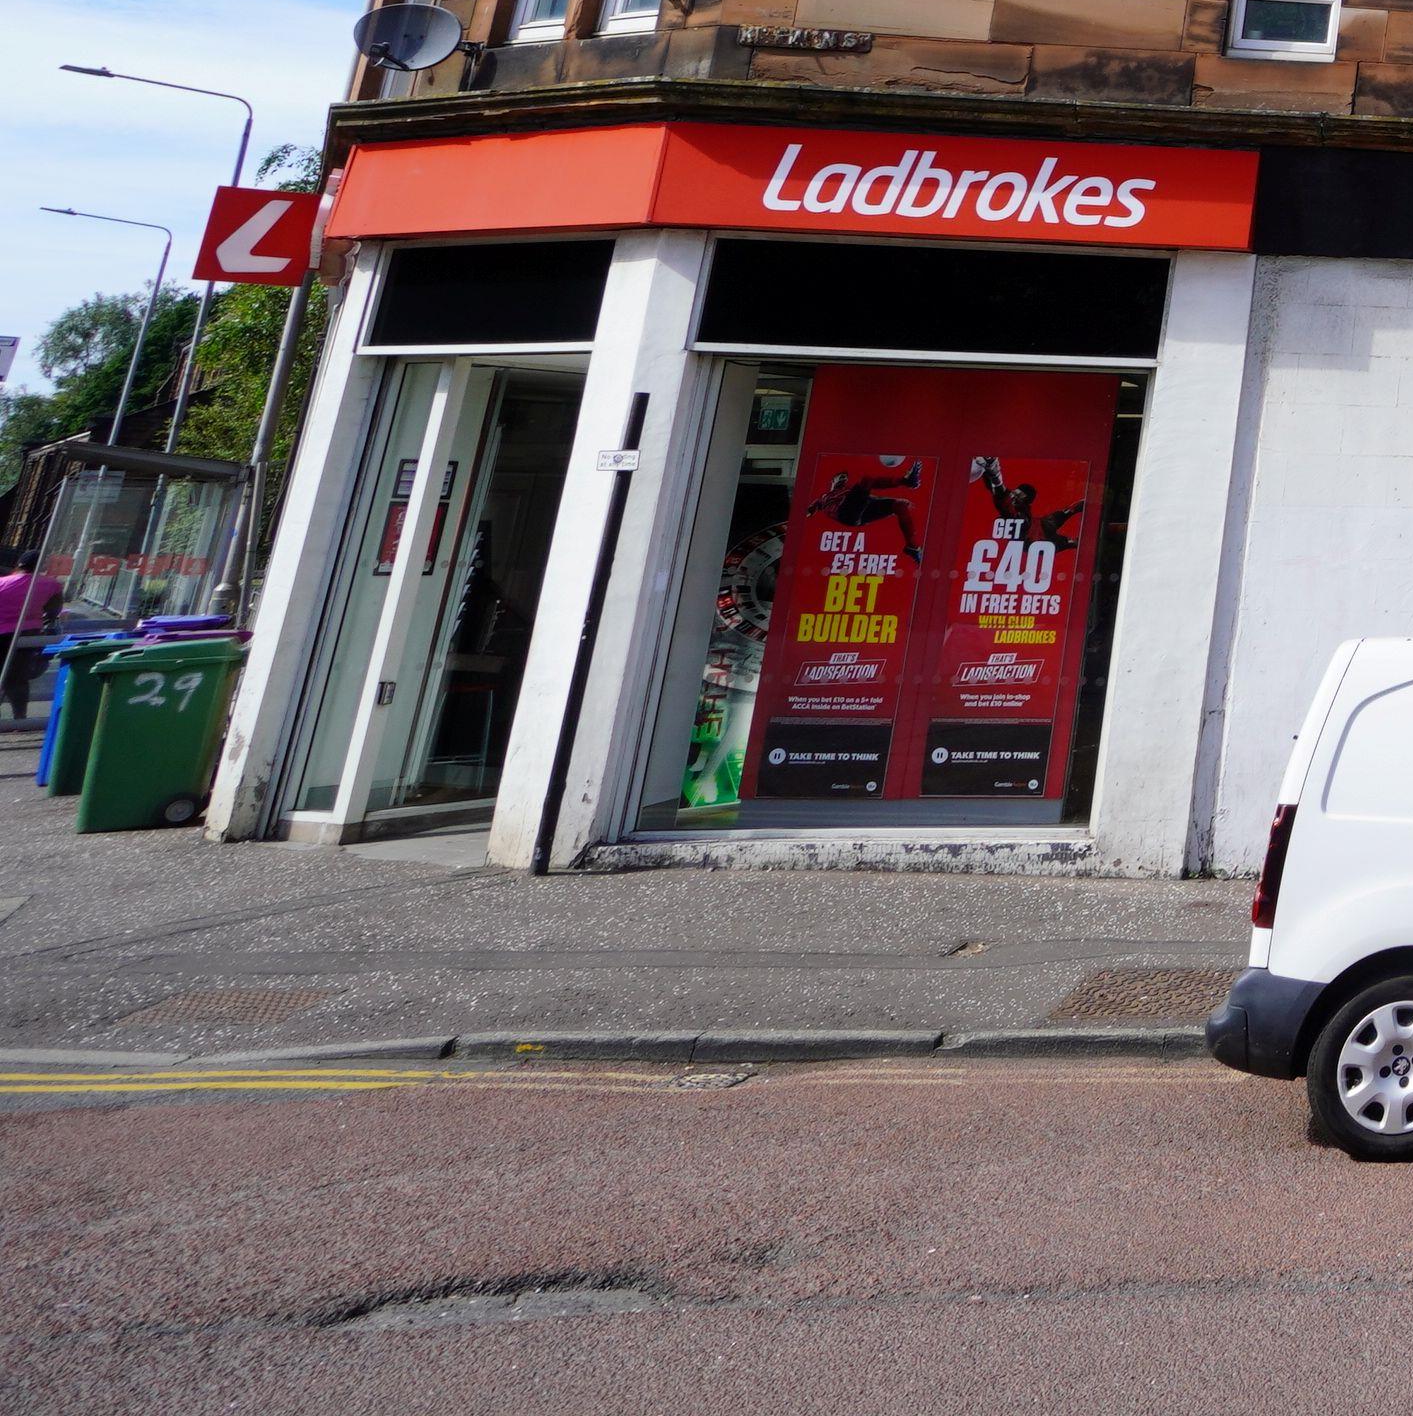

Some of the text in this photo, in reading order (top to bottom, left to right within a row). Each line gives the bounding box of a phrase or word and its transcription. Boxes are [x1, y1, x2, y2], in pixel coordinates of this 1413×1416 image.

[763, 144, 1156, 228] Ladbrokes
[992, 518, 1025, 540] GET
[820, 531, 865, 552] GET A
[830, 553, 897, 575] £5 FREE
[963, 539, 1056, 593] £40
[824, 575, 884, 613] BET
[960, 593, 1061, 615] IN FREE BETS
[797, 613, 898, 643] BUILDER
[978, 615, 1035, 629] WITH CLUB
[994, 630, 1056, 644] LADBROKES
[960, 664, 1037, 682] LADISFACTION
[128, 672, 203, 712] 29
[789, 753, 879, 761] TAKE TIME TO THINK
[951, 752, 1040, 760] TAKE TIME TO THINK
